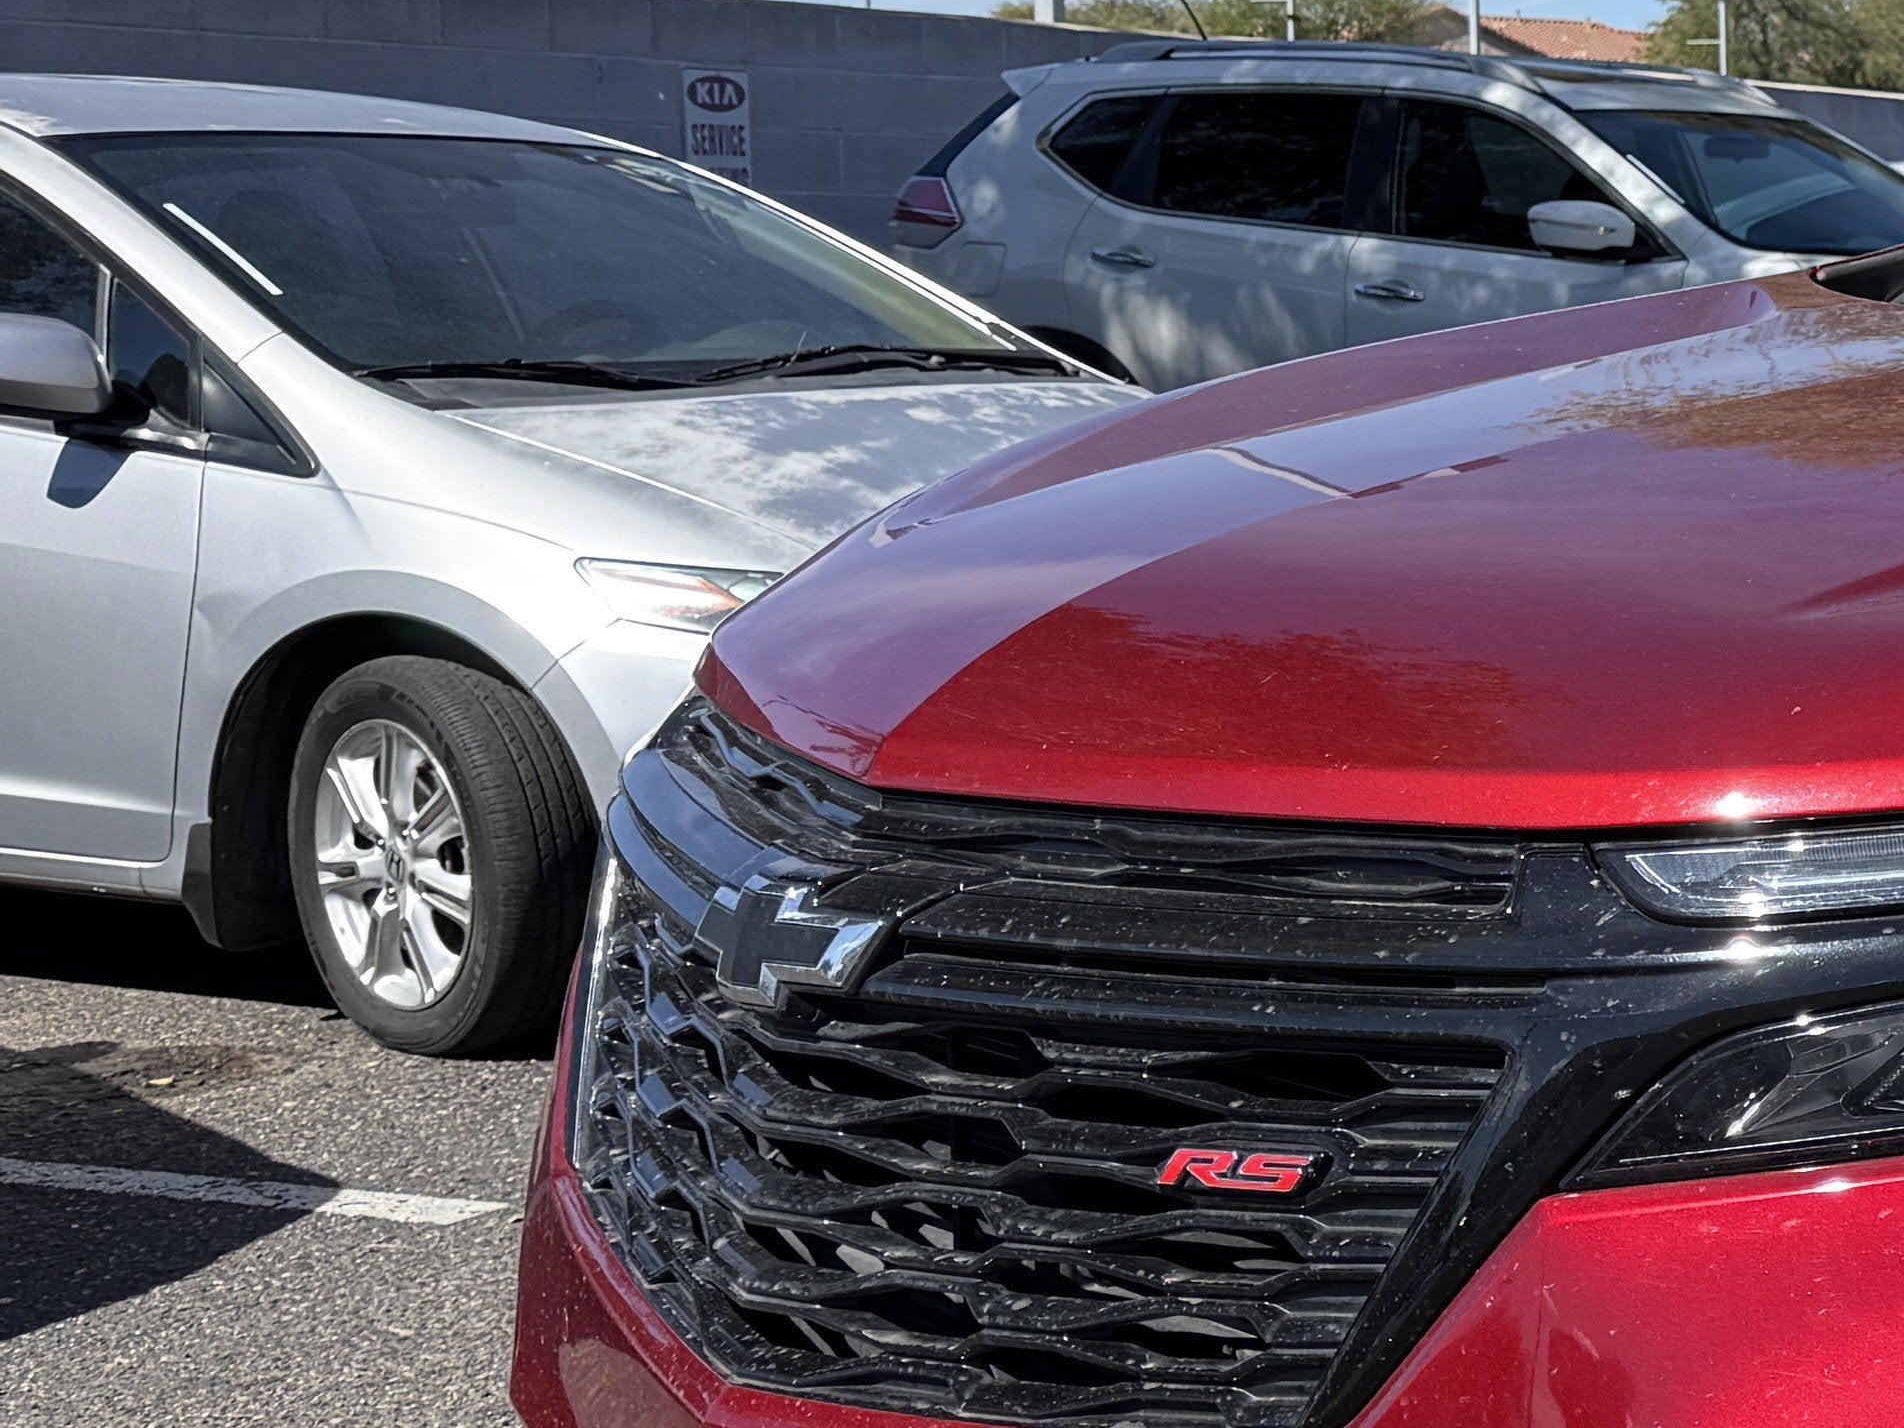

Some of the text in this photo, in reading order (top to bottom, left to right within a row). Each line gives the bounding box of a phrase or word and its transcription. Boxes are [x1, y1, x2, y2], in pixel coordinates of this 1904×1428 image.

[696, 83, 738, 104] KIA
[691, 124, 746, 156] SERVICE
[1157, 1148, 1312, 1192] RS
